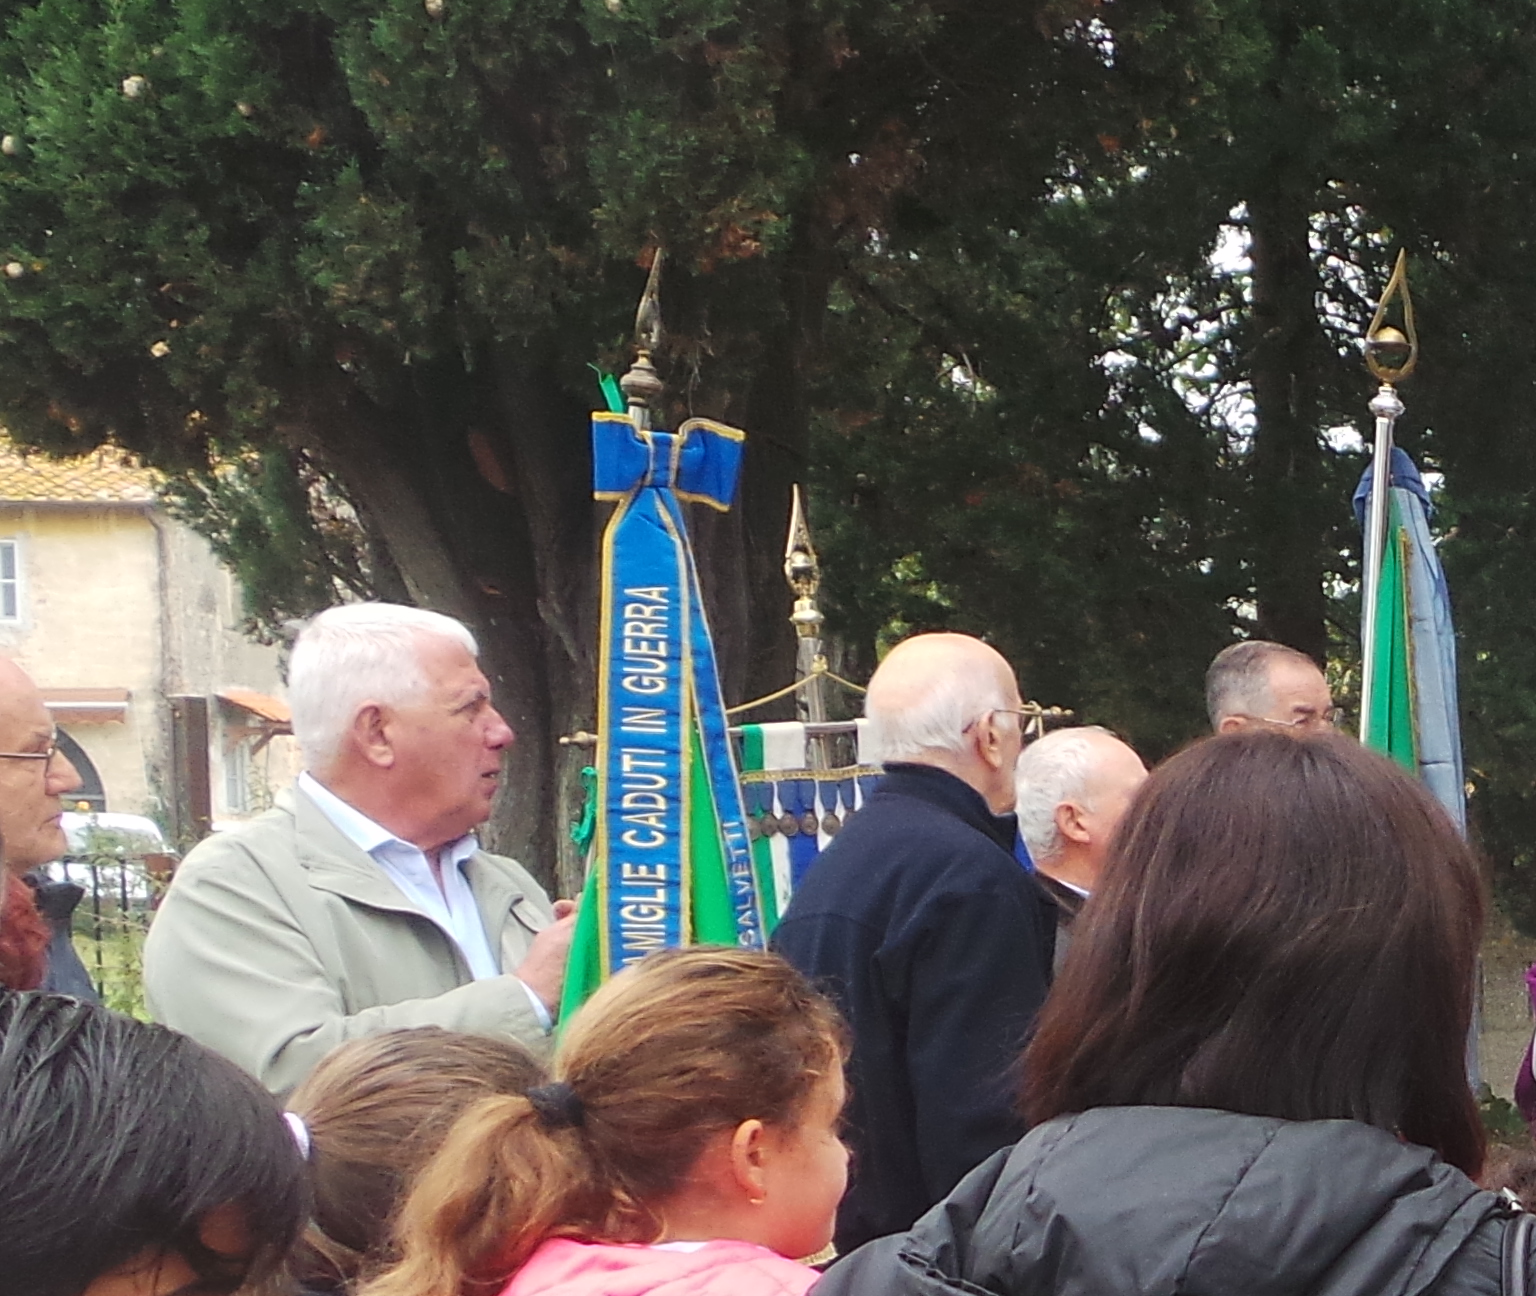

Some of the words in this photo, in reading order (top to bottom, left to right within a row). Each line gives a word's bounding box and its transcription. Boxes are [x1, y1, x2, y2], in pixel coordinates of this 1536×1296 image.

[621, 586, 670, 695] GUERRA
[620, 706, 668, 734] IN
[620, 747, 668, 848] CADUTI
